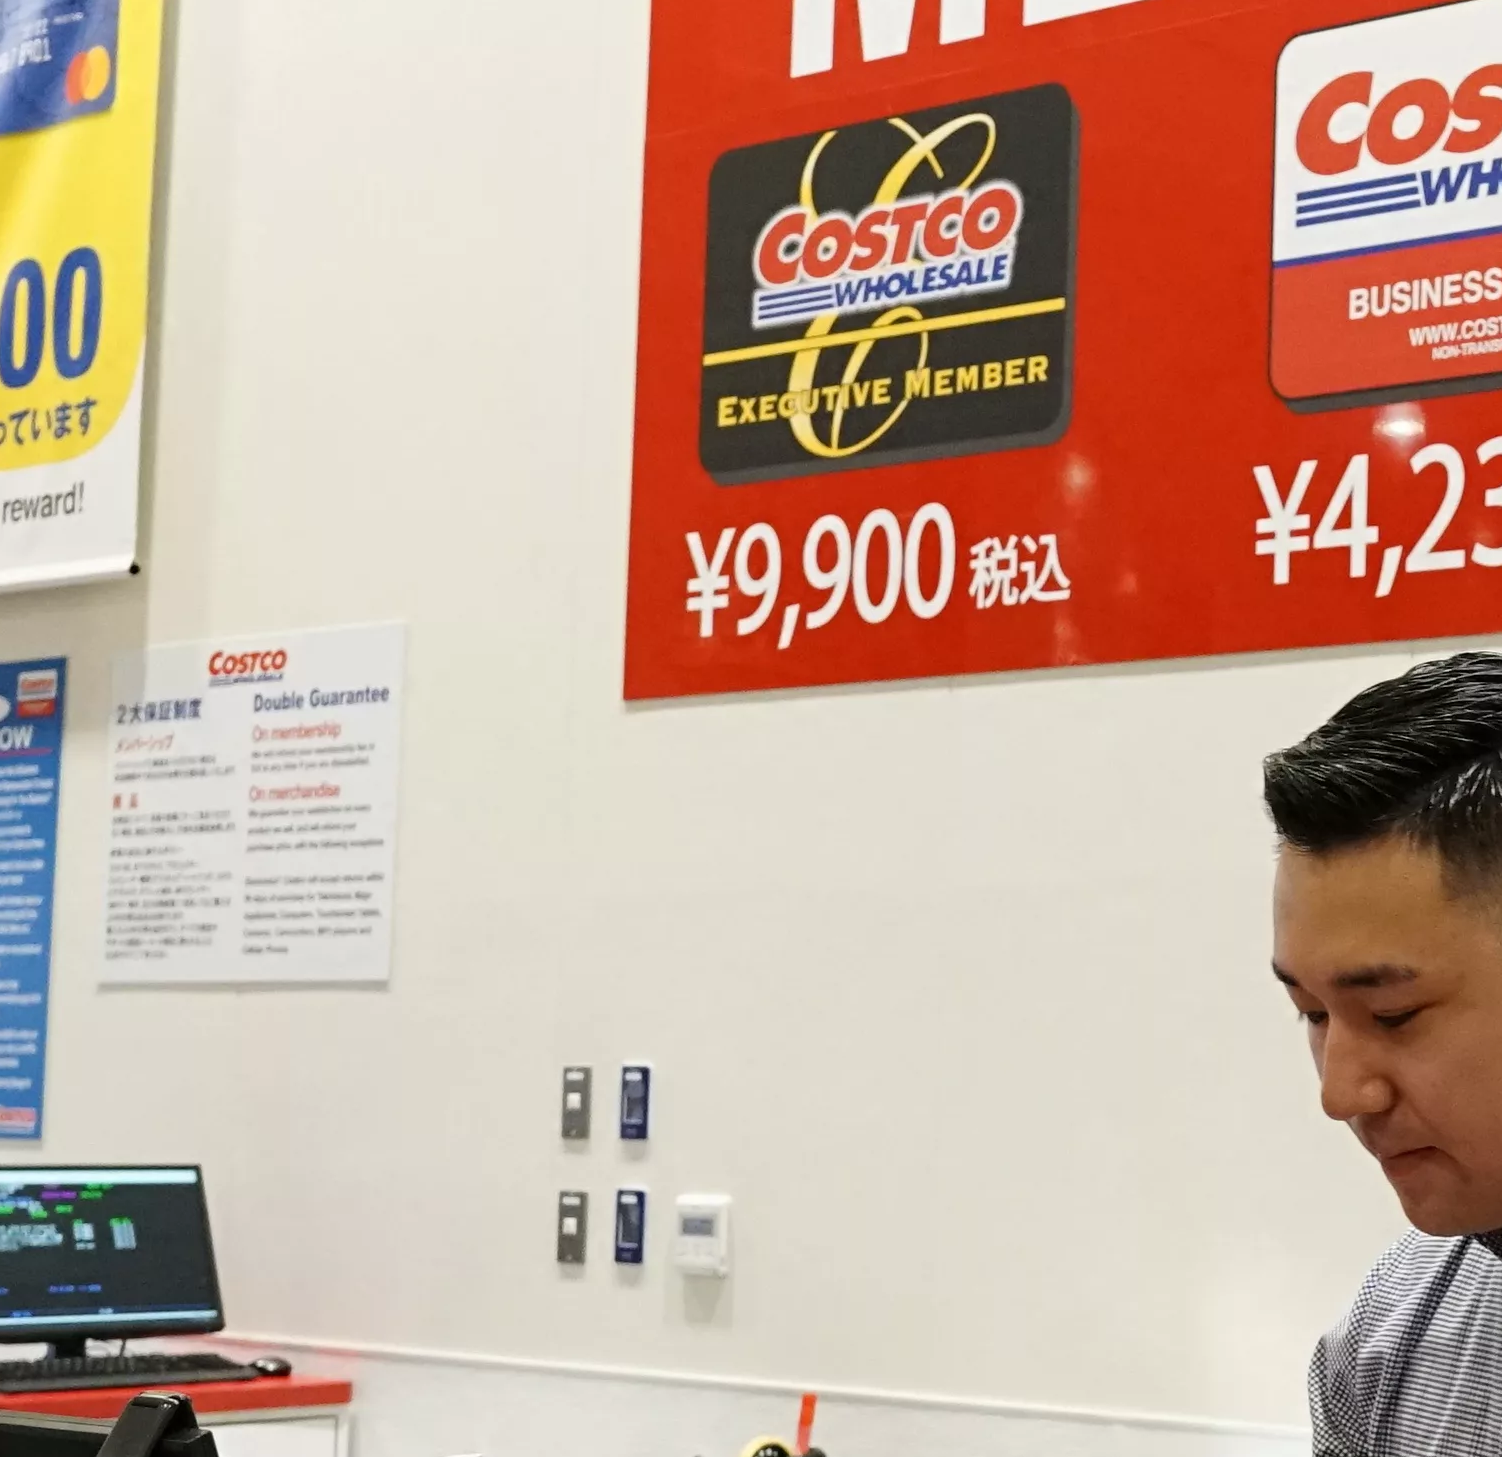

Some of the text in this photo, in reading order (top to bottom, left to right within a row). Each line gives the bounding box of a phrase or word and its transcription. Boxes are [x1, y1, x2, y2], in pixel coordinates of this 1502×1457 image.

[757, 187, 1018, 286] COSTCO
[834, 253, 1009, 307] WHOLESALE
[1, 479, 86, 524] reward!
[685, 502, 1072, 650] ¥9,900 税込
[207, 649, 289, 678] COSTCO
[253, 684, 390, 714] Double Guarantee
